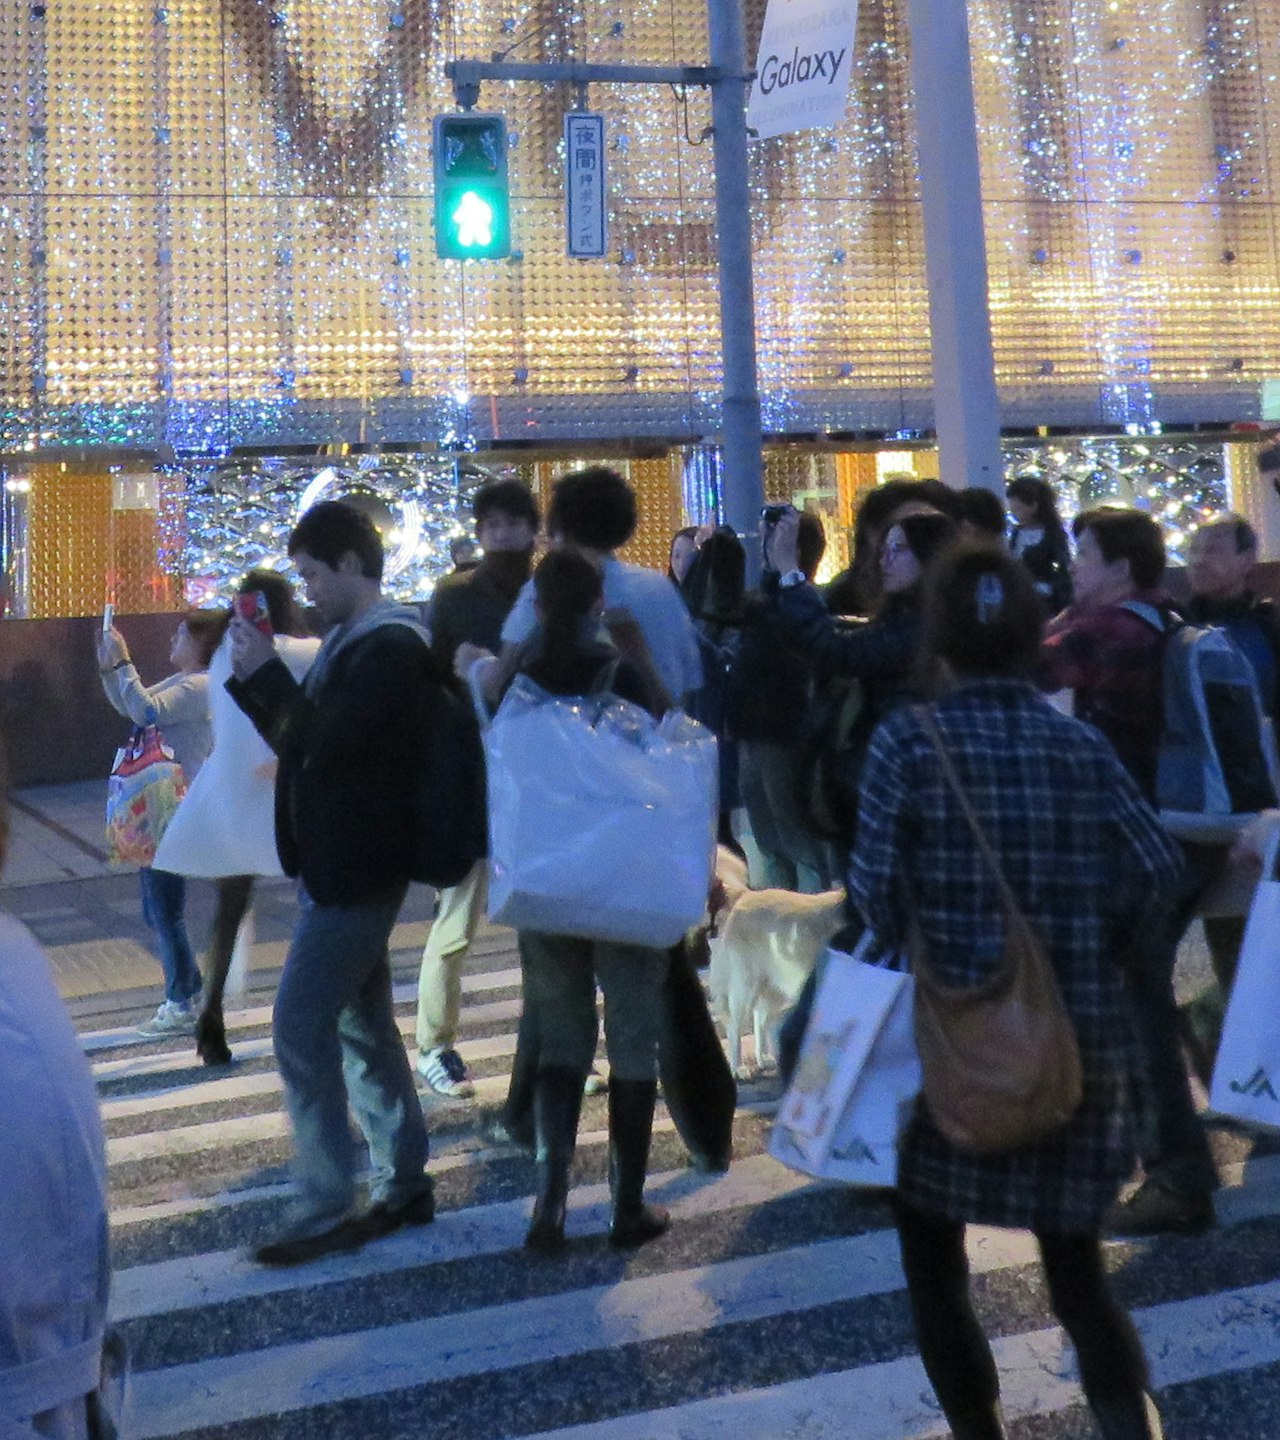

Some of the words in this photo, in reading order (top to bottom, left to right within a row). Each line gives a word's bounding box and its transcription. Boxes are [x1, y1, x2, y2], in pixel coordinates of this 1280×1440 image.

[760, 46, 845, 95] Galaxy
[575, 126, 596, 248] 夜間押ボタン式
